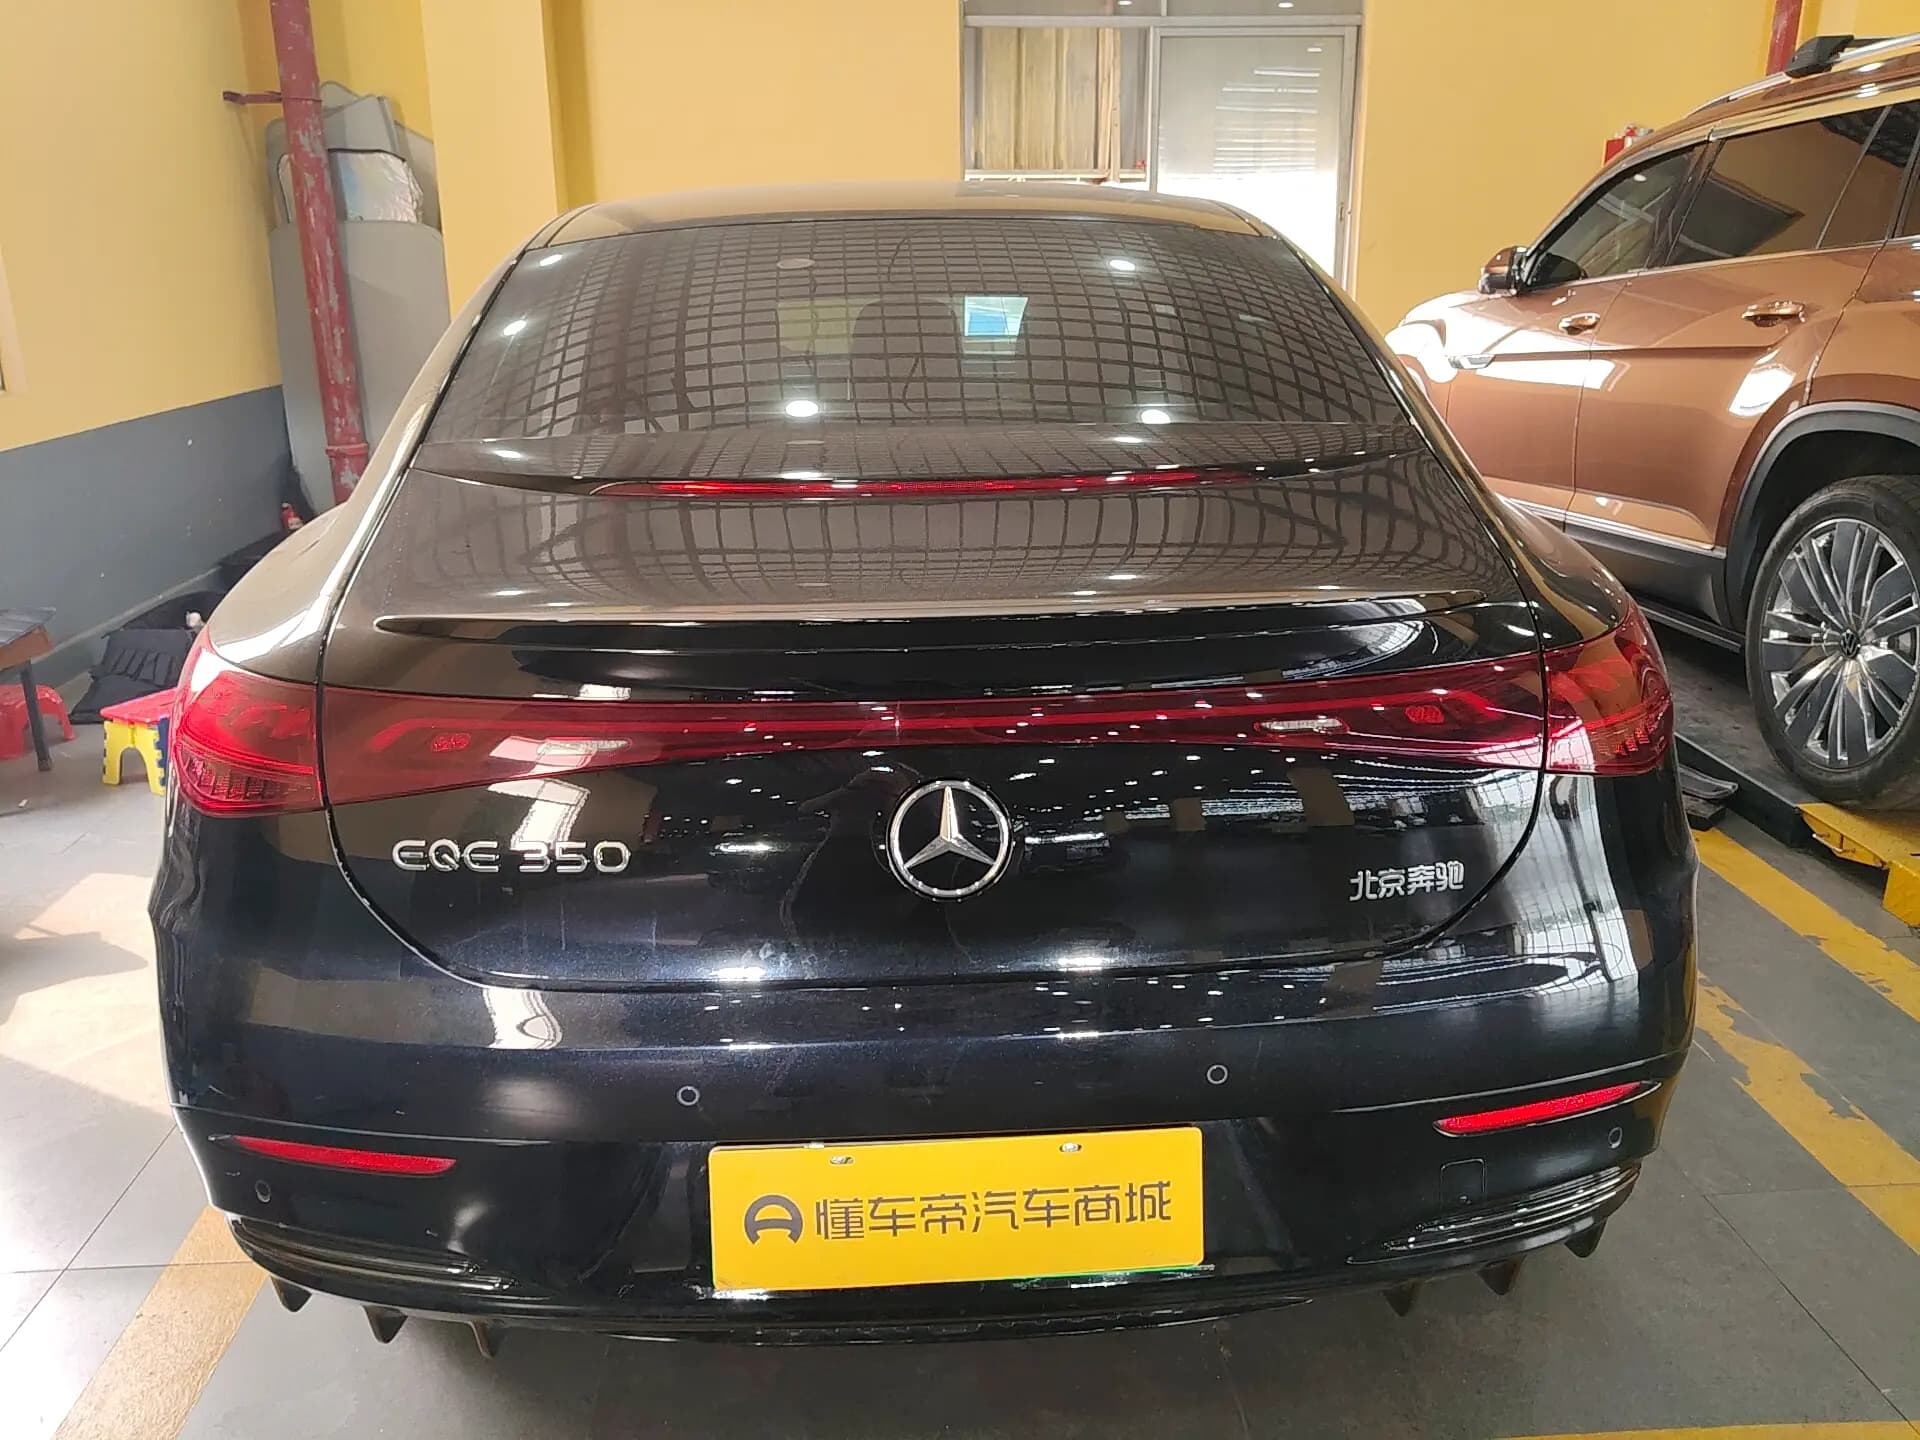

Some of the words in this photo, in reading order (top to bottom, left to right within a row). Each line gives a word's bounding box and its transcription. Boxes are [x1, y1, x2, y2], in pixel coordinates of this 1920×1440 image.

[391, 838, 499, 873] EQE
[518, 840, 631, 873] 350
[1349, 860, 1465, 902] 北京奔驰
[815, 1180, 1172, 1240] 懂车帝汽车商城
